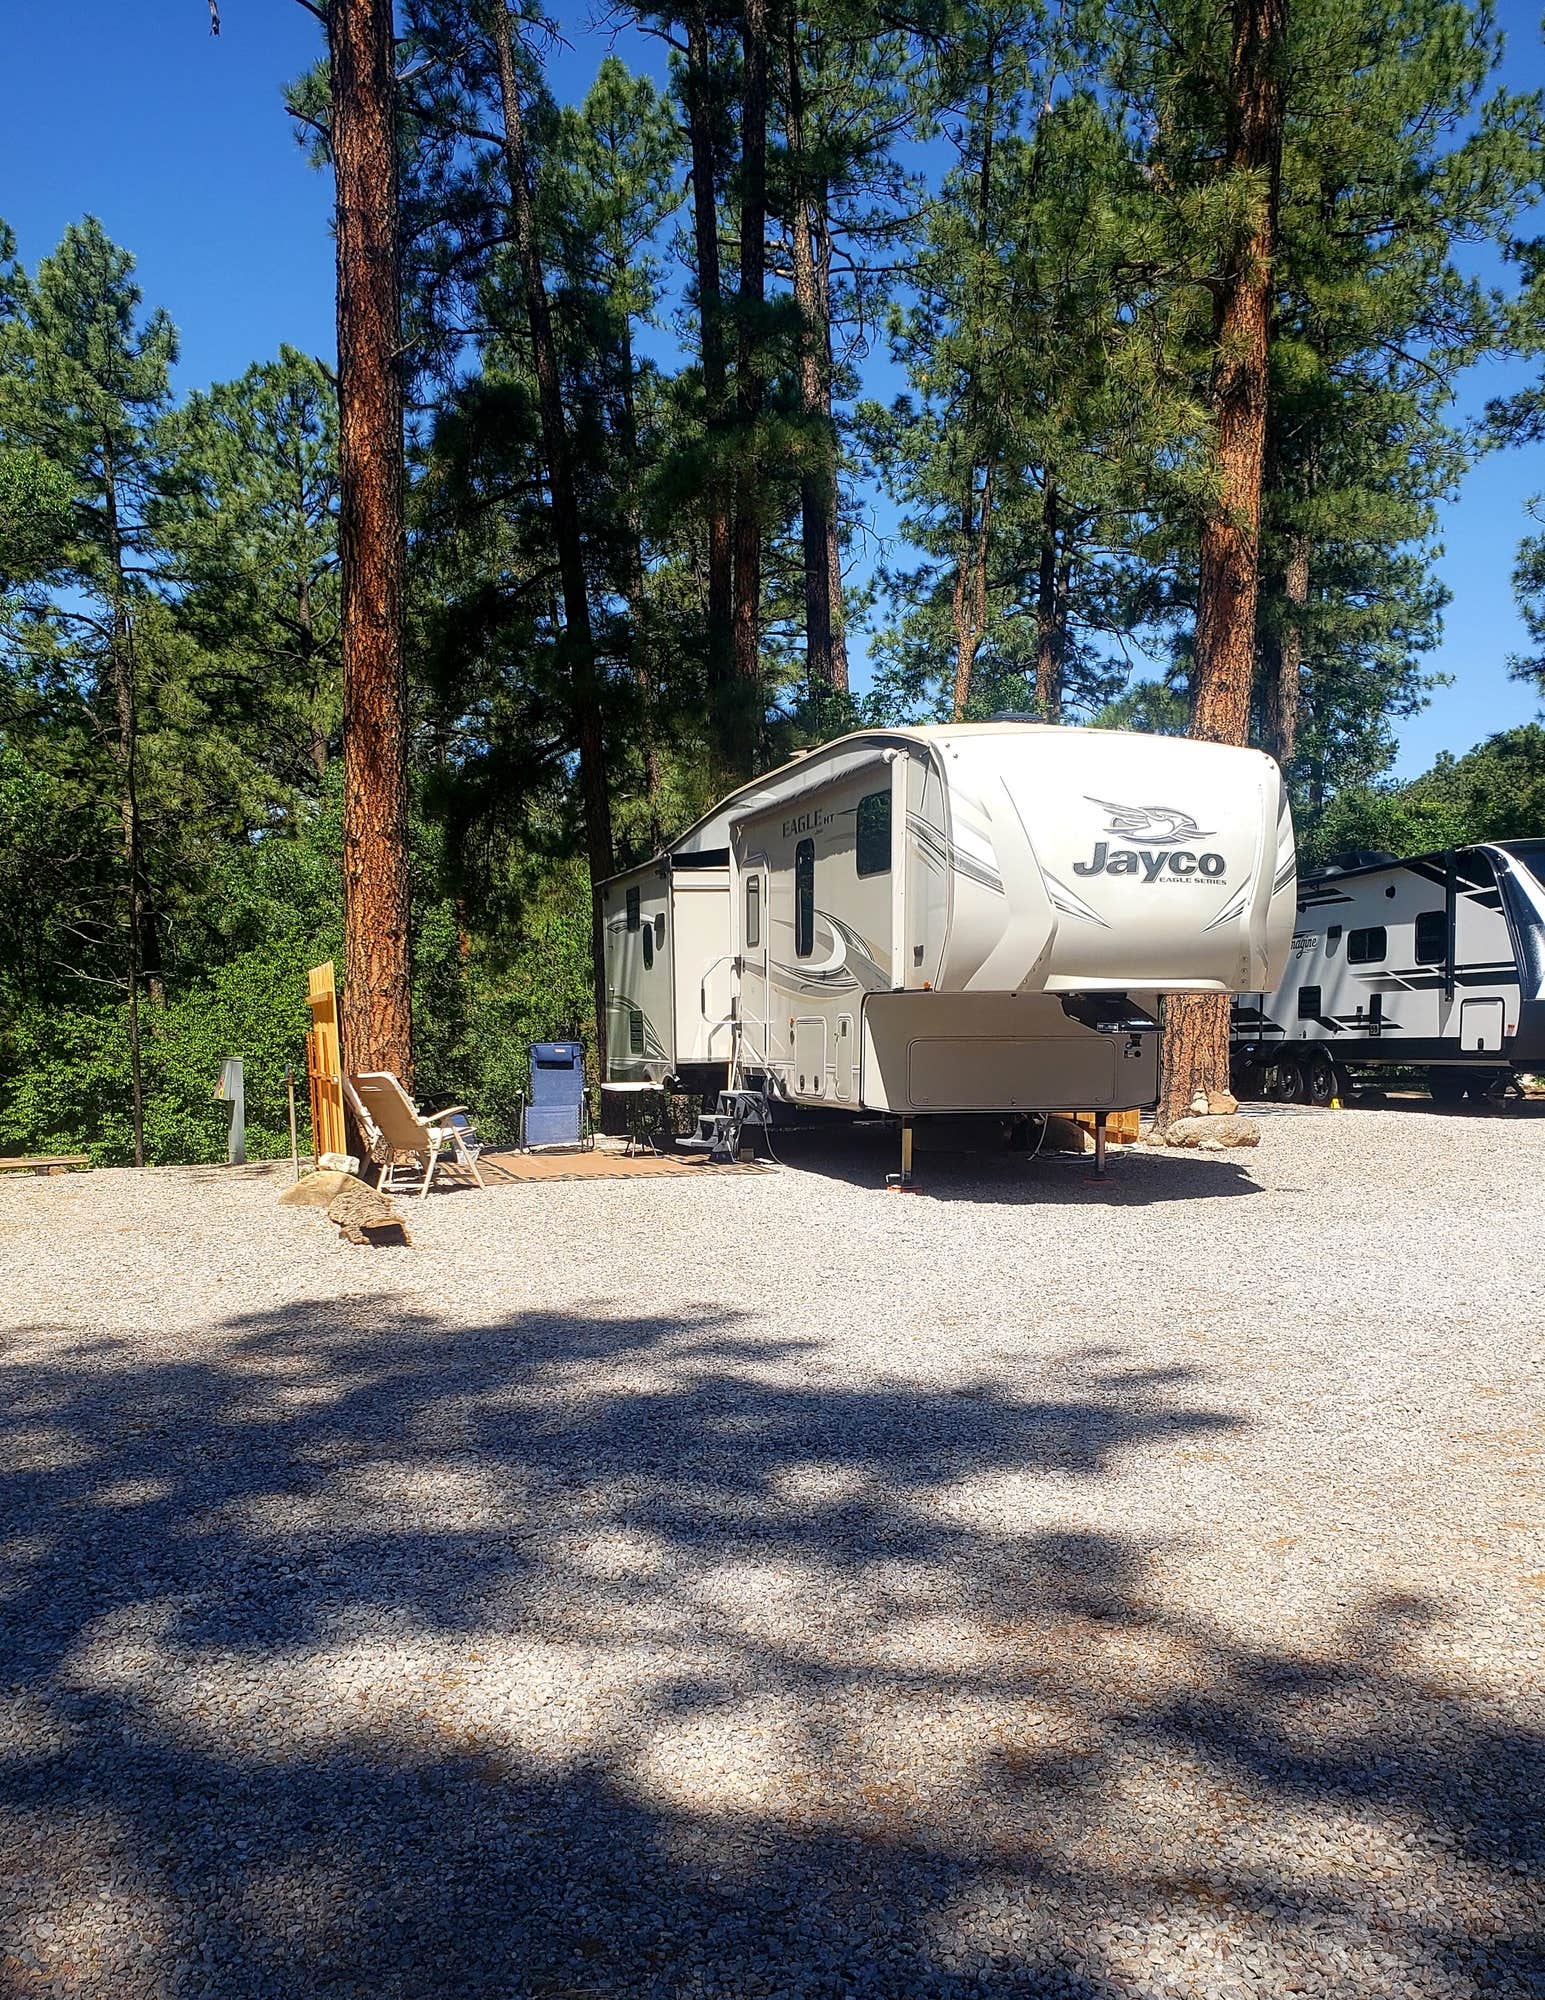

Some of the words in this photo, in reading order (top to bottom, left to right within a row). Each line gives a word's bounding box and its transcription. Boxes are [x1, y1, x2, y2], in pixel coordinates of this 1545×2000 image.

[782, 809, 823, 839] EAGLE
[1073, 842, 1226, 883] Jayco
[1194, 878, 1227, 886] SERIES
